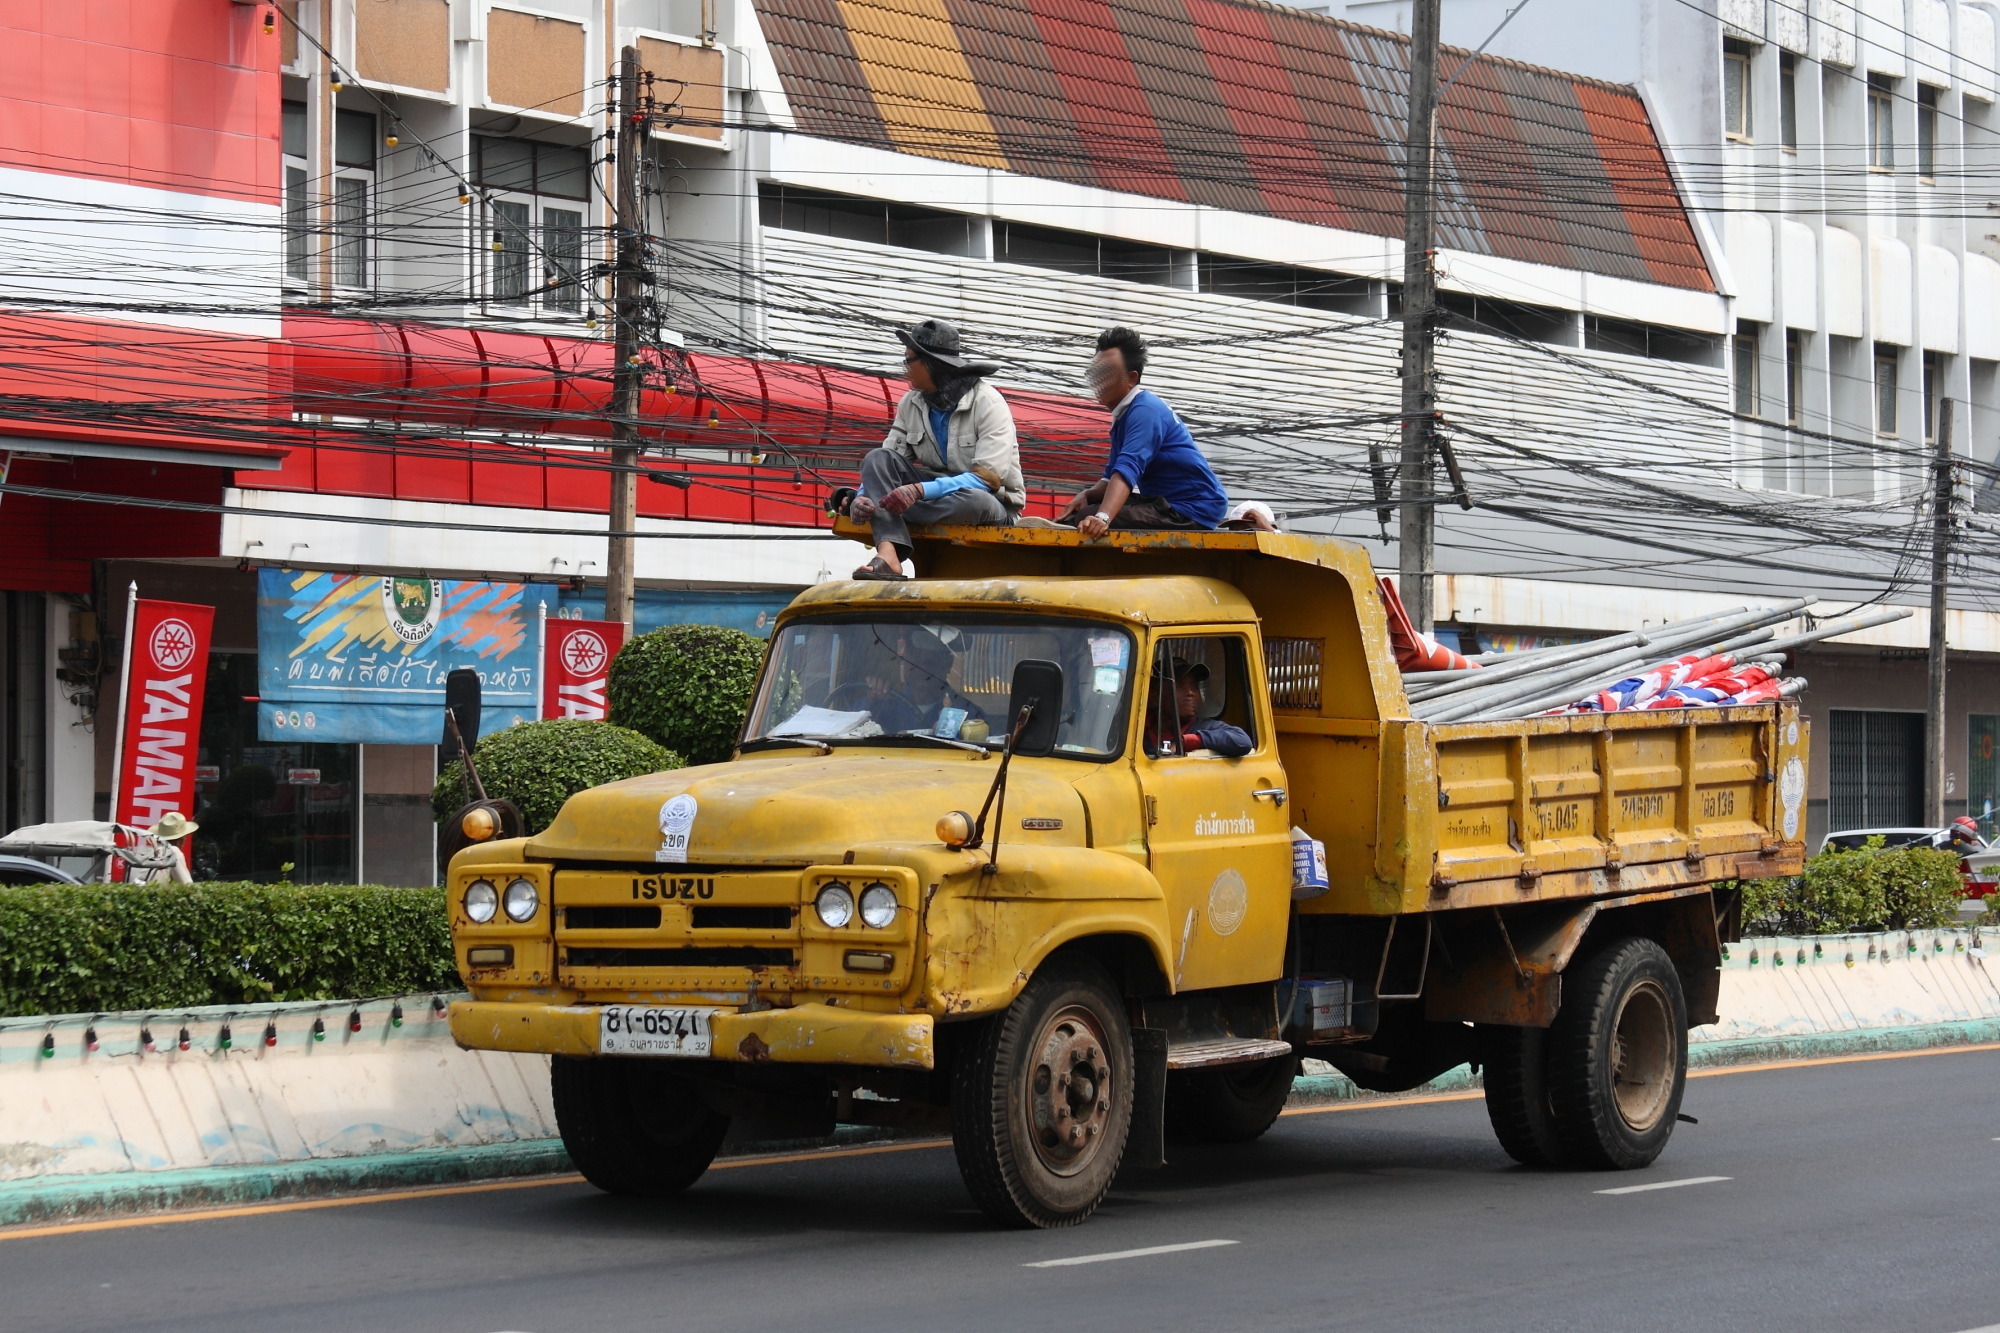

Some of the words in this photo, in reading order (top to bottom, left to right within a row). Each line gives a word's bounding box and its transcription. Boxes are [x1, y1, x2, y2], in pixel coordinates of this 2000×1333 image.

[129, 673, 193, 851] YAMAH
[632, 878, 714, 900] ISUZU
[695, 1042, 707, 1051] 32
